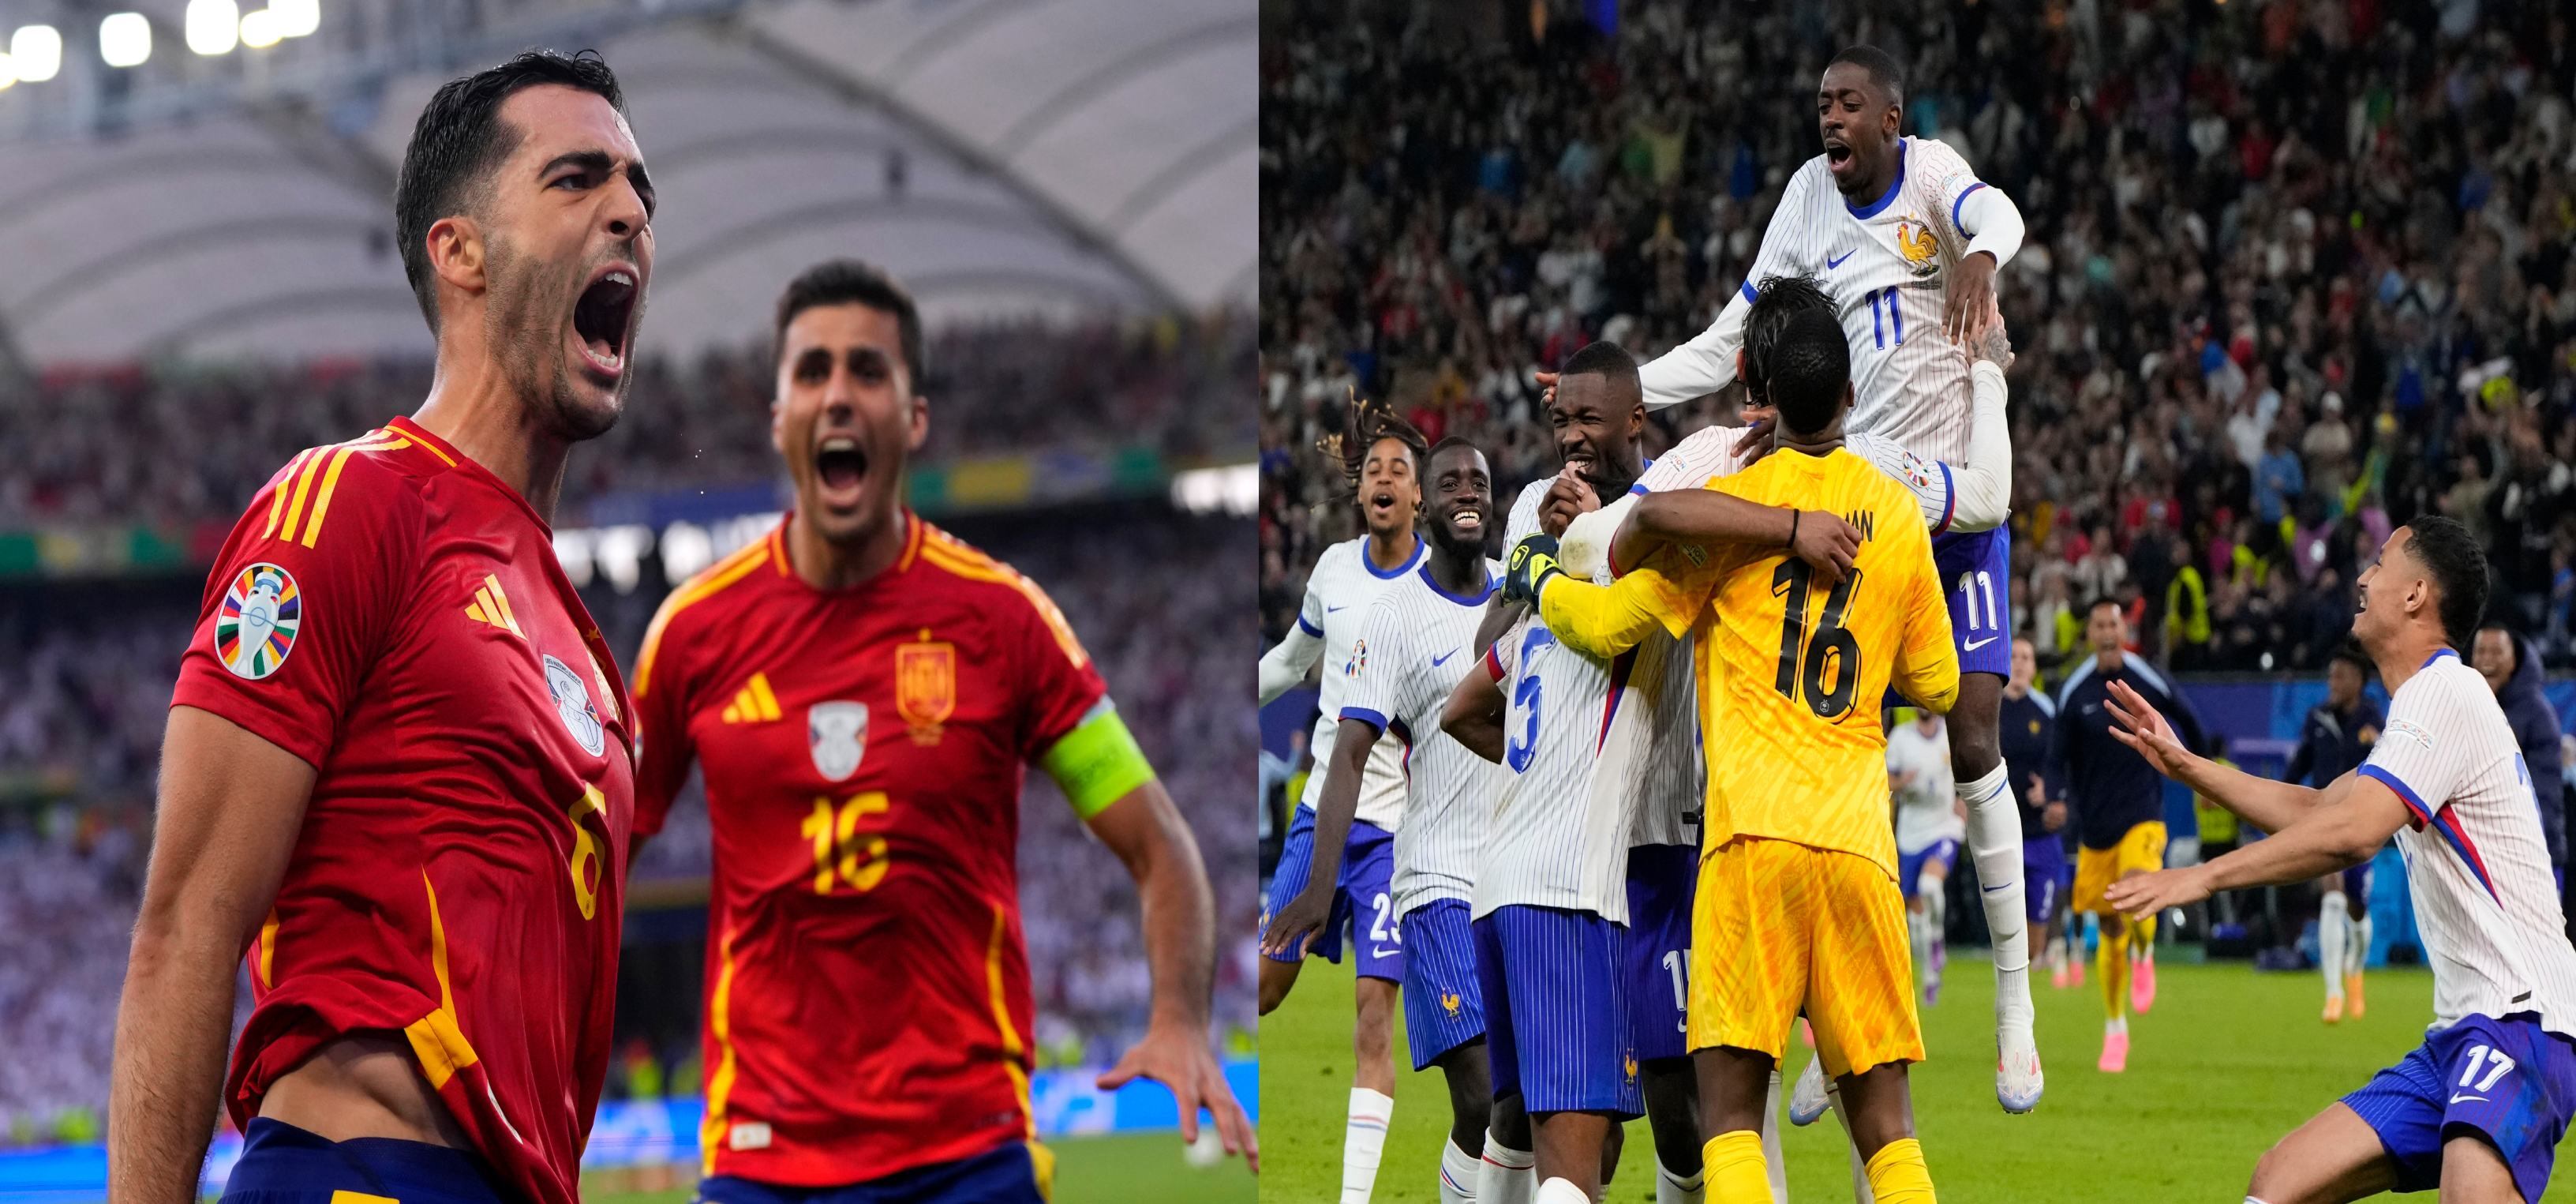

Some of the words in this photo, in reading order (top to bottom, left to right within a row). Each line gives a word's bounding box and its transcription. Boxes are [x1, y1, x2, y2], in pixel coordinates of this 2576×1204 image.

[1865, 285, 1904, 350] 11
[1845, 509, 1874, 542] AN
[1772, 557, 1863, 725] 16
[1959, 571, 1998, 630] 11
[1507, 626, 1556, 775] 5
[567, 781, 607, 921] 6
[800, 790, 889, 895] 16
[2458, 1045, 2515, 1093] 17
